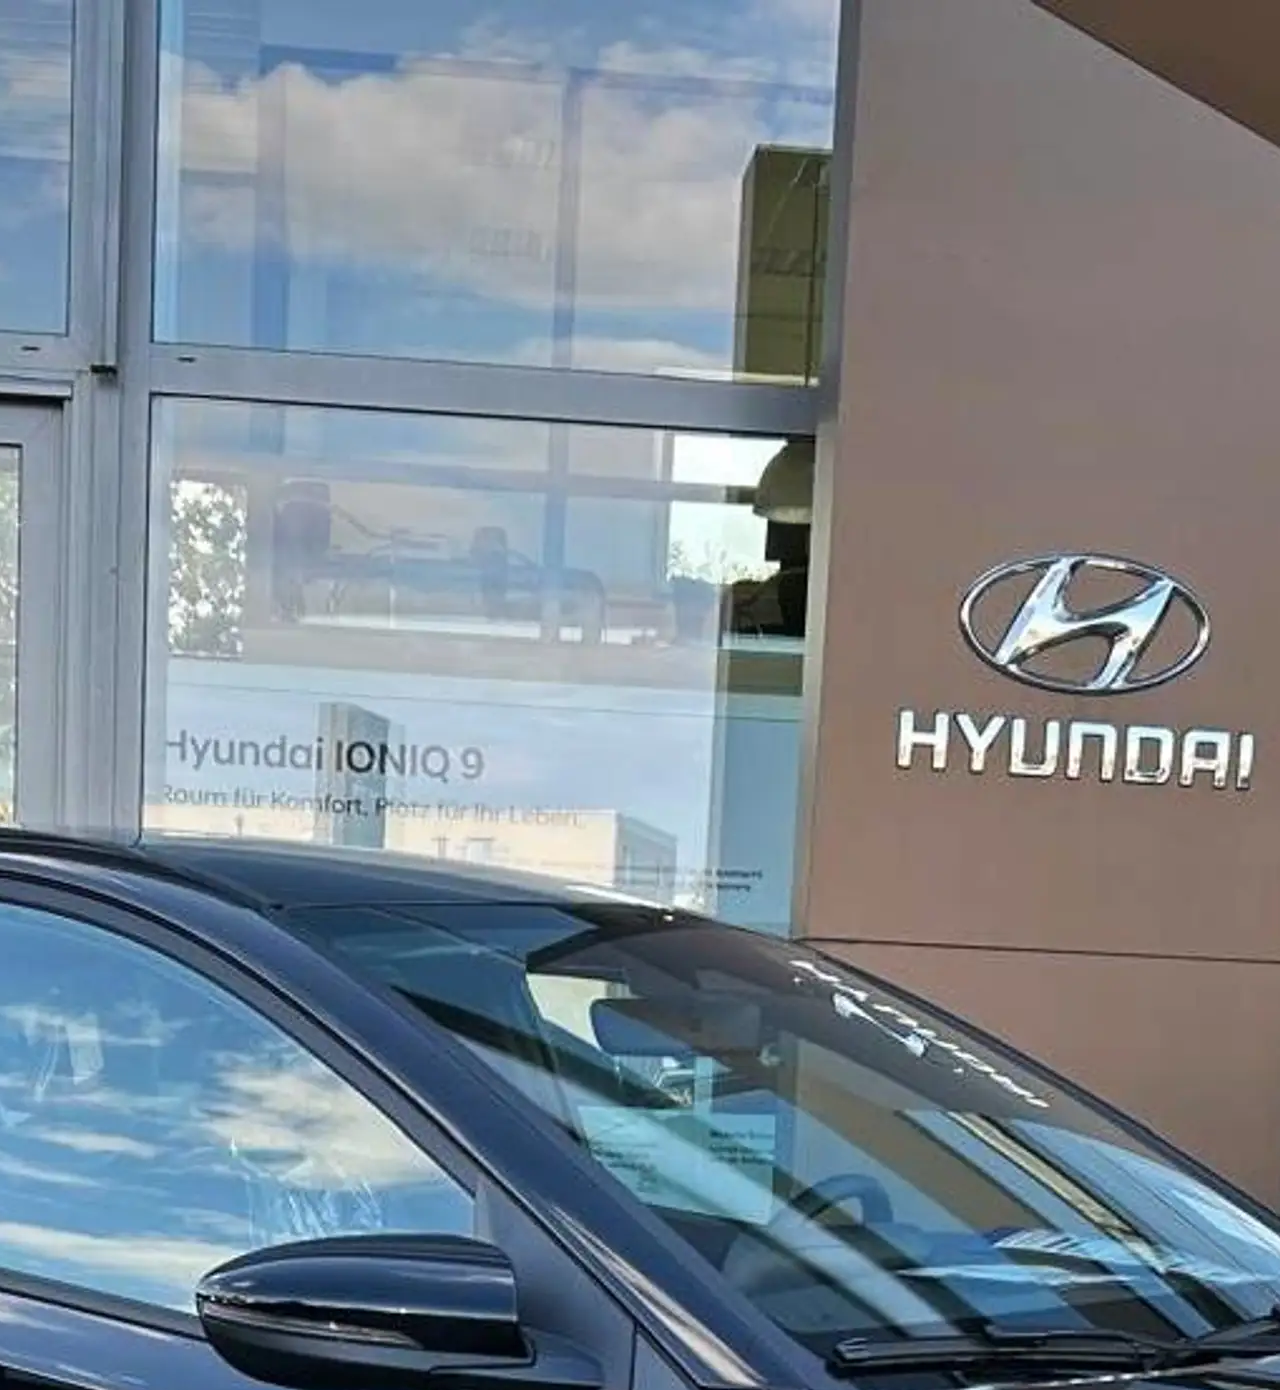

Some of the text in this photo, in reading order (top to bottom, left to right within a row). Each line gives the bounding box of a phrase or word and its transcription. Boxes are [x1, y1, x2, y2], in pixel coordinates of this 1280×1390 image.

[165, 729, 485, 784] Hyundai IONIQ 9
[896, 708, 1255, 790] HYUNDAI
[233, 785, 267, 809] für
[436, 802, 470, 822] für
